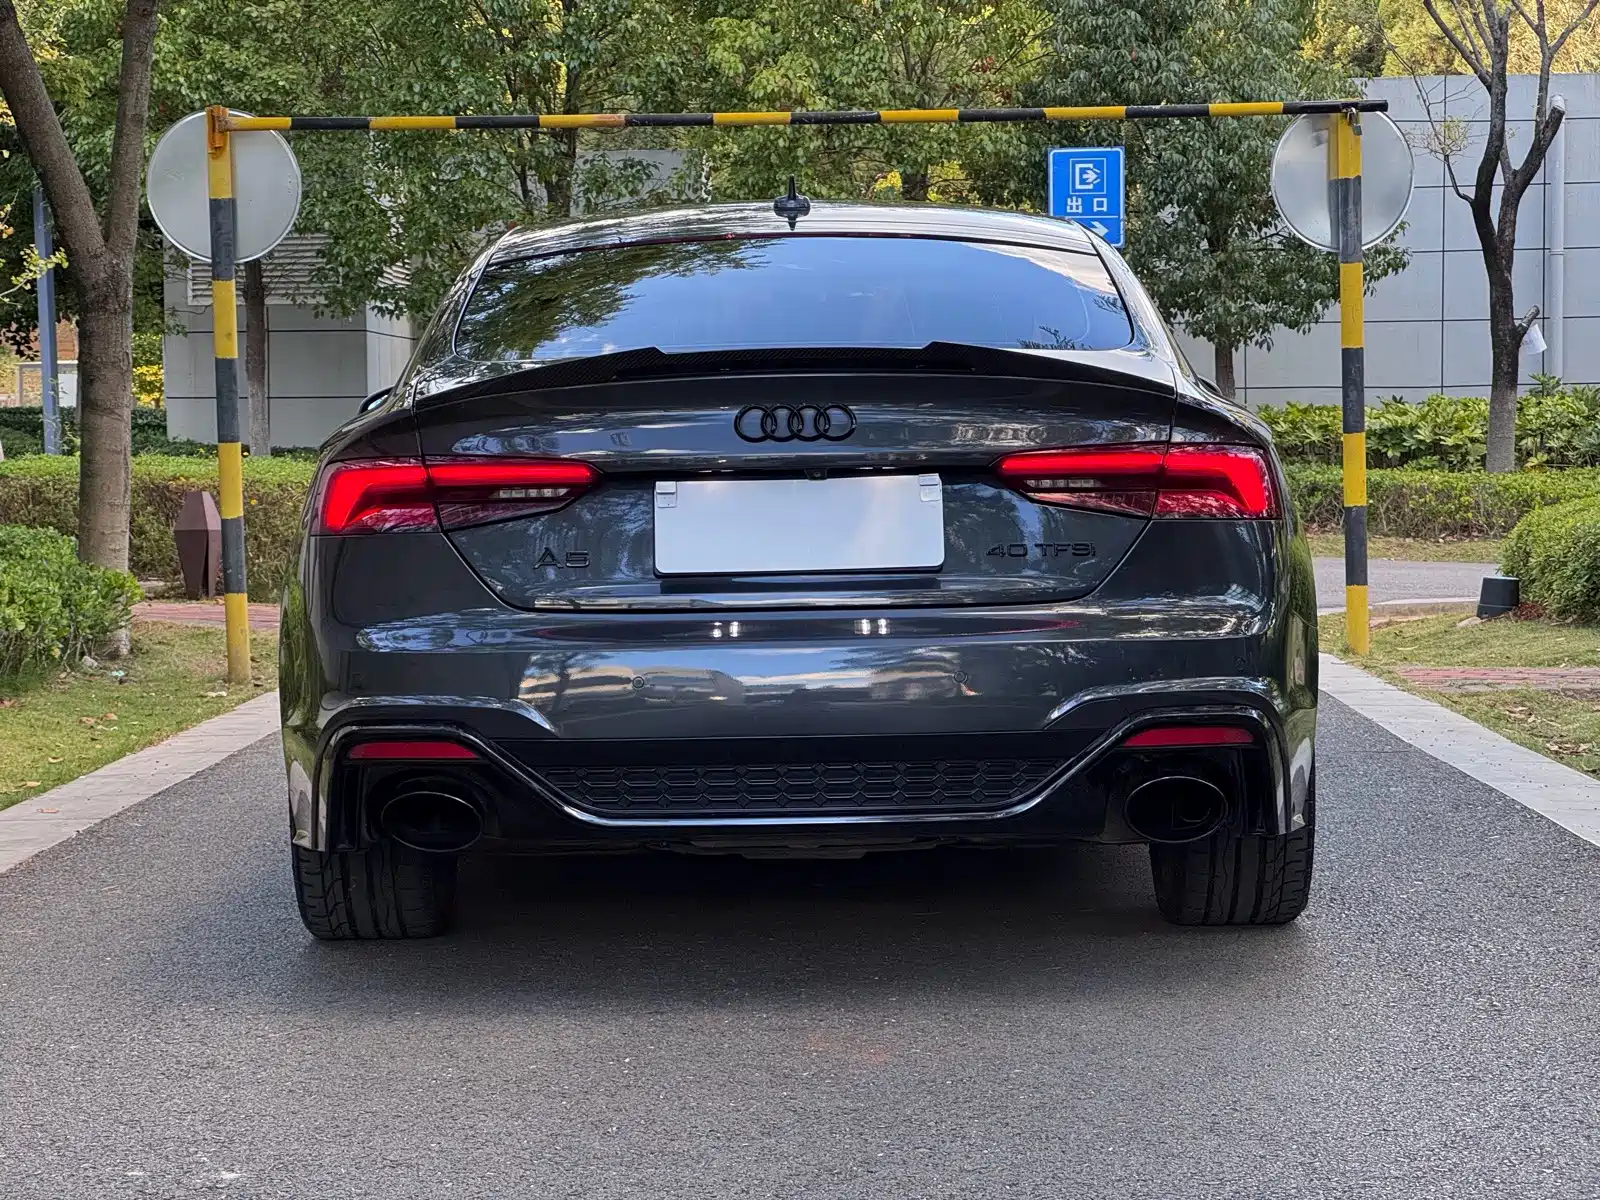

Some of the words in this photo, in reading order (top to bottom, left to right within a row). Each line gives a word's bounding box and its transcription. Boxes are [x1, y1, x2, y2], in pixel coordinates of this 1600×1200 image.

[1066, 196, 1107, 213] 出口
[533, 547, 590, 569] A5
[985, 543, 1028, 558] 40
